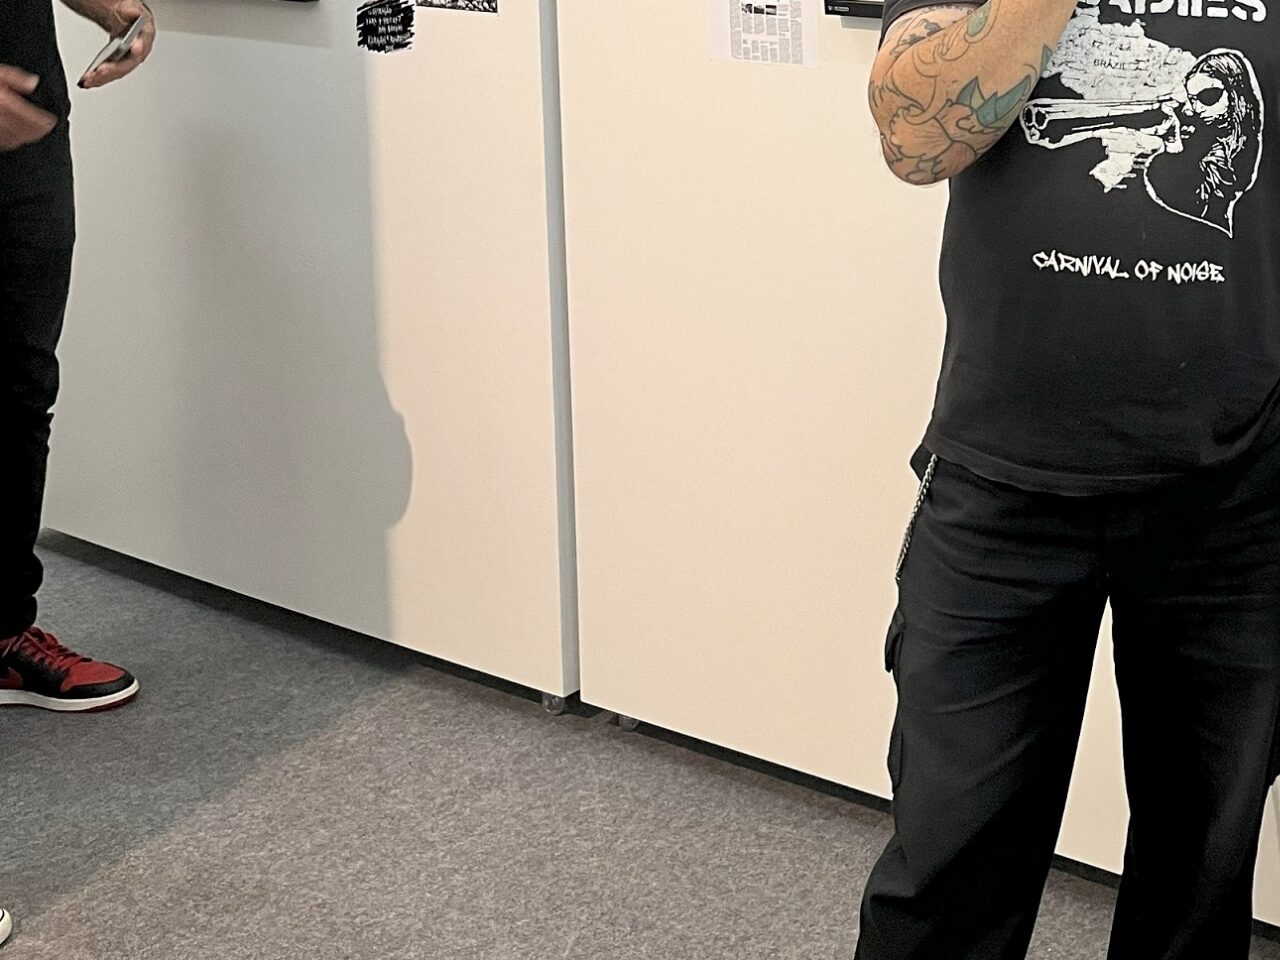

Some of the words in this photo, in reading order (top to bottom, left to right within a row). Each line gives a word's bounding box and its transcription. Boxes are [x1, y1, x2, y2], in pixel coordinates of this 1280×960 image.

[1033, 249, 1130, 279] CARNIVAL
[1134, 259, 1163, 281] OF
[1167, 260, 1225, 285] NOISE
